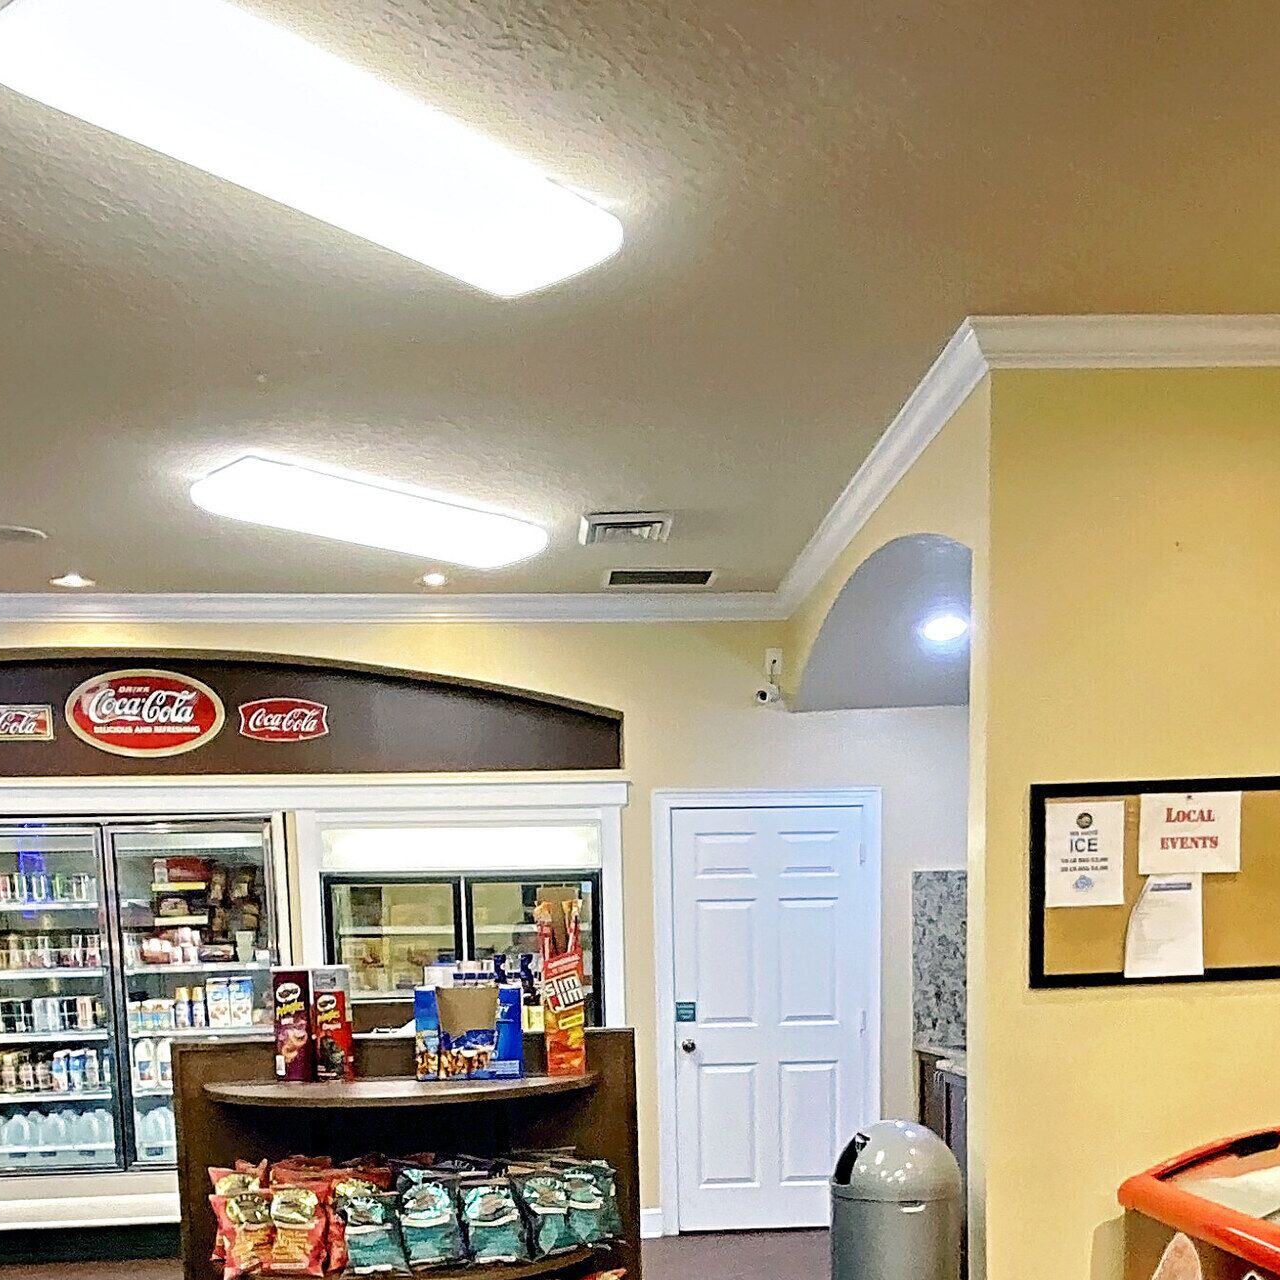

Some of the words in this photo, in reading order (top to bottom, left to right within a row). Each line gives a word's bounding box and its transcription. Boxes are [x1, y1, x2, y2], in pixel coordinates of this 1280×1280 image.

[89, 688, 198, 724] Coca-Cola
[248, 707, 321, 732] Coca-Cola
[134, 725, 153, 734] AND
[1165, 807, 1216, 823] LOCAL
[1069, 838, 1099, 853] ICE
[1160, 836, 1219, 850] EVENTS
